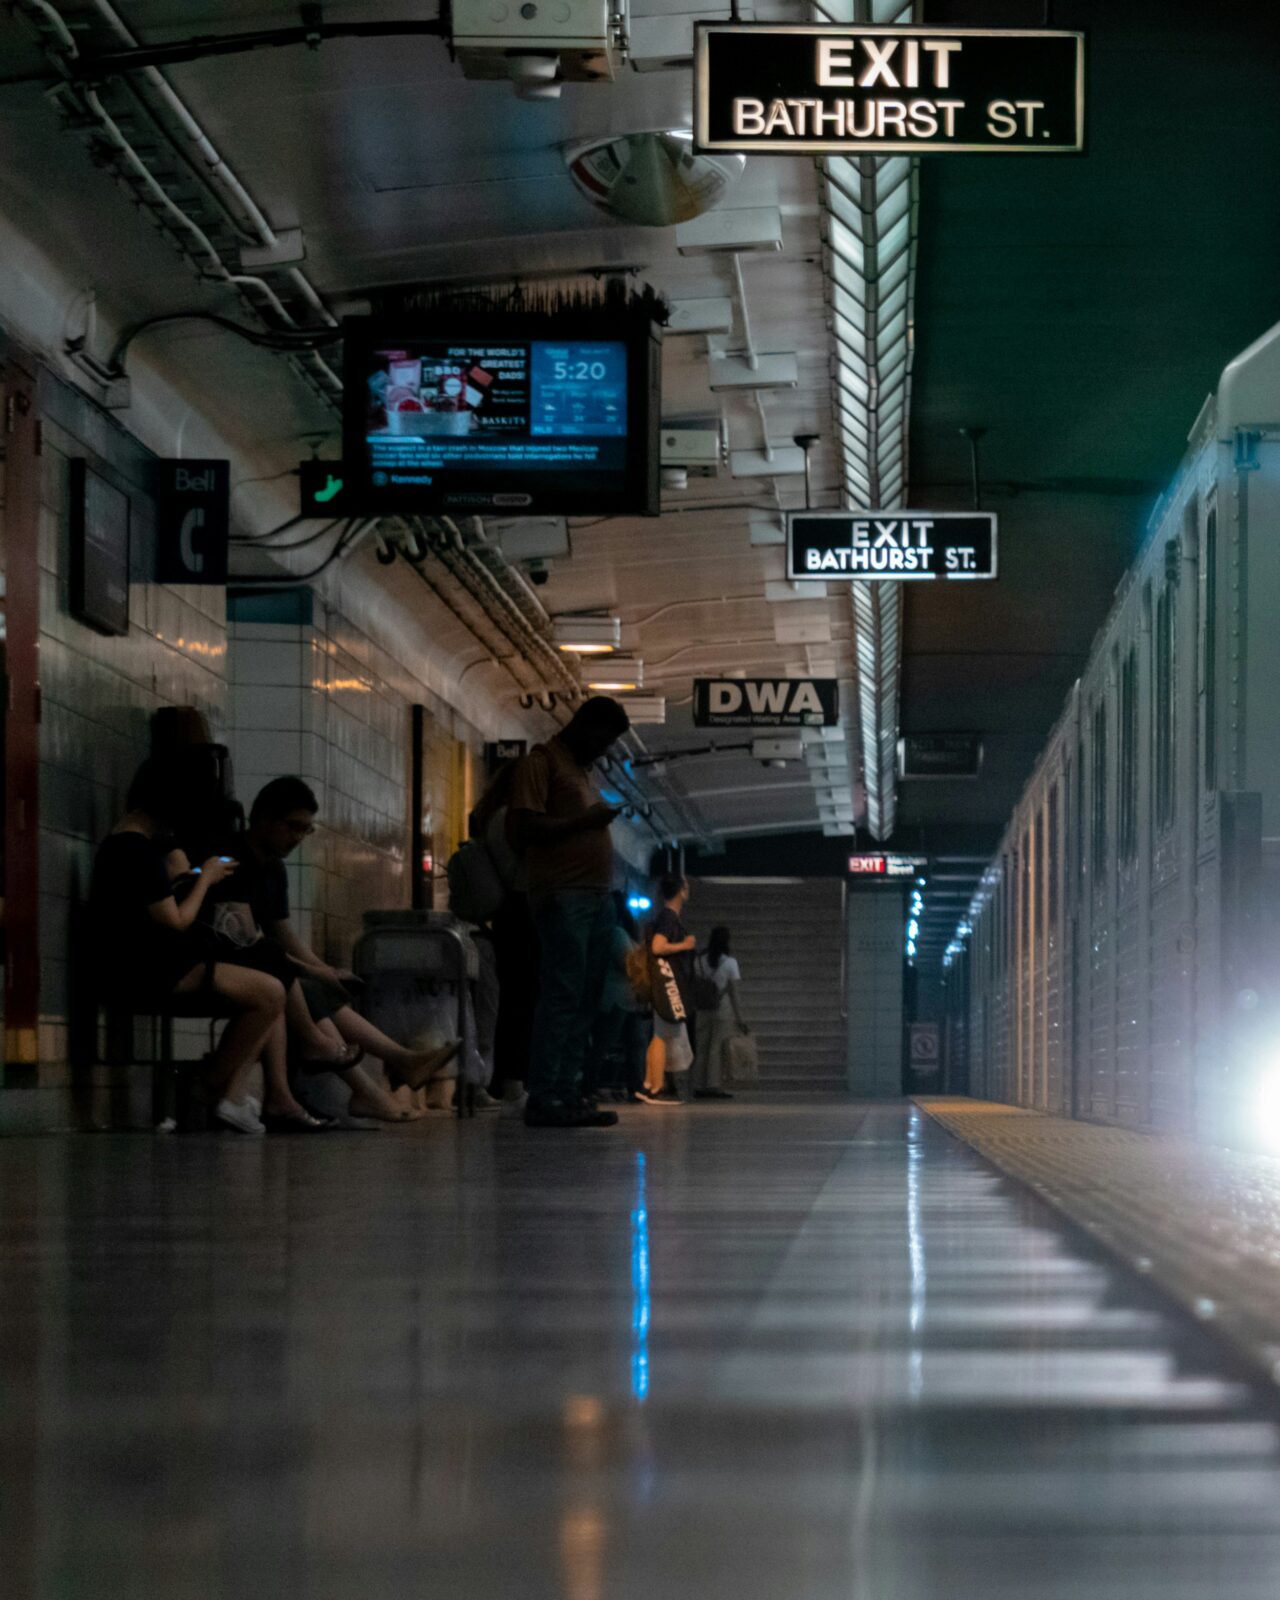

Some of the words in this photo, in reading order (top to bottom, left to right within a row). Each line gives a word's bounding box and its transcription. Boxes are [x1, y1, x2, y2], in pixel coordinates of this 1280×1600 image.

[816, 39, 962, 88] EXIT
[733, 97, 965, 138] BATHURST
[987, 101, 1050, 138] ST.
[448, 348, 466, 357] FOR
[468, 348, 485, 357] THE
[487, 348, 526, 357] WORLD'S
[480, 359, 526, 369] GREATEST
[554, 361, 606, 380] 5:20
[482, 416, 526, 425] BASKITS
[175, 468, 215, 491] Bell
[391, 474, 432, 486] Kennedy
[447, 496, 491, 504] PATTISON
[852, 521, 934, 548] EXIT
[806, 548, 933, 570] BATHURST
[945, 547, 976, 569] ST.
[708, 681, 824, 714] DWA
[753, 715, 780, 725] Waiting
[783, 715, 801, 724] Area
[497, 744, 520, 758] Bell
[849, 856, 881, 873] EXIT
[664, 978, 688, 1020] YONEX
